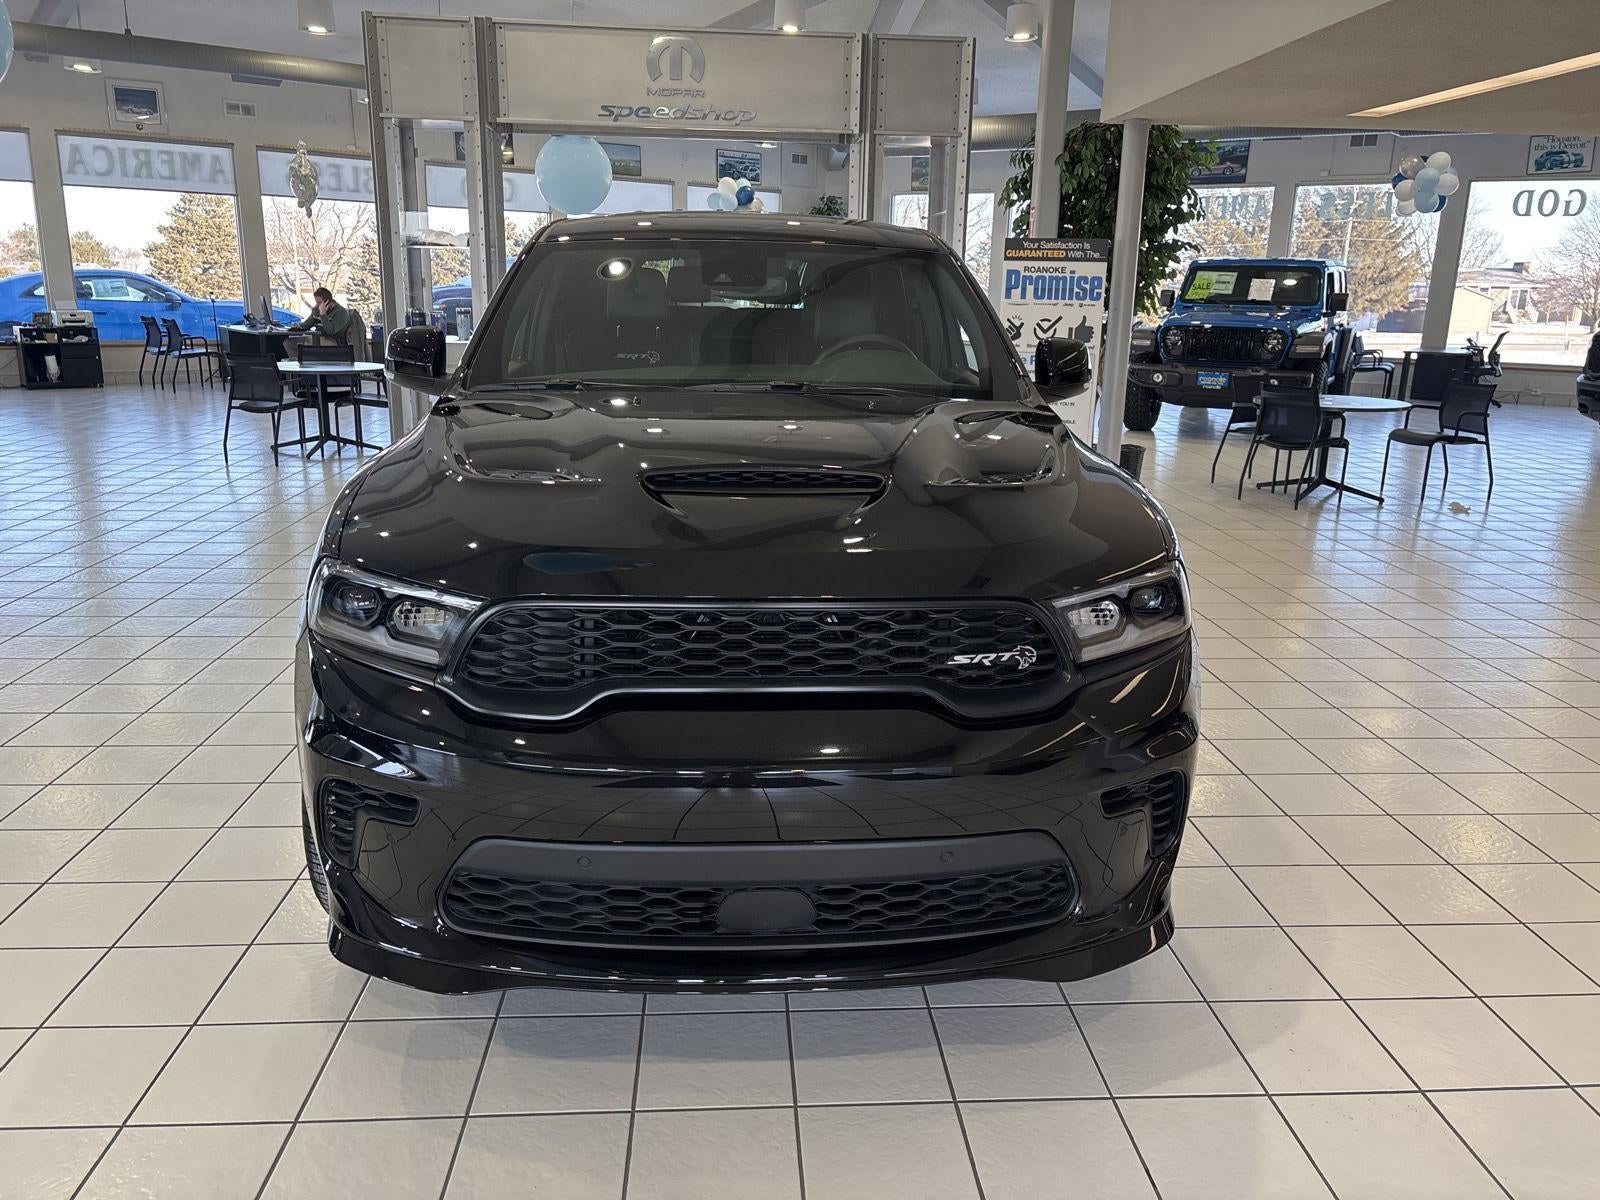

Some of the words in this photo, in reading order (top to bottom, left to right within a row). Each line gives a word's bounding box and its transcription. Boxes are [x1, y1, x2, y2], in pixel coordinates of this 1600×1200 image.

[647, 87, 705, 98] MOPAR
[598, 104, 757, 126] speedshop
[1023, 241, 1039, 249] Your
[1040, 241, 1082, 249] Satisfaction
[1006, 249, 1066, 258] GUARANTEED
[1067, 250, 1084, 258] With
[1086, 250, 1106, 259] The...
[1023, 266, 1067, 274] ROANOKE
[1005, 269, 1103, 301] Promise
[1192, 283, 1211, 291] SALE
[947, 652, 1020, 666] SRT
